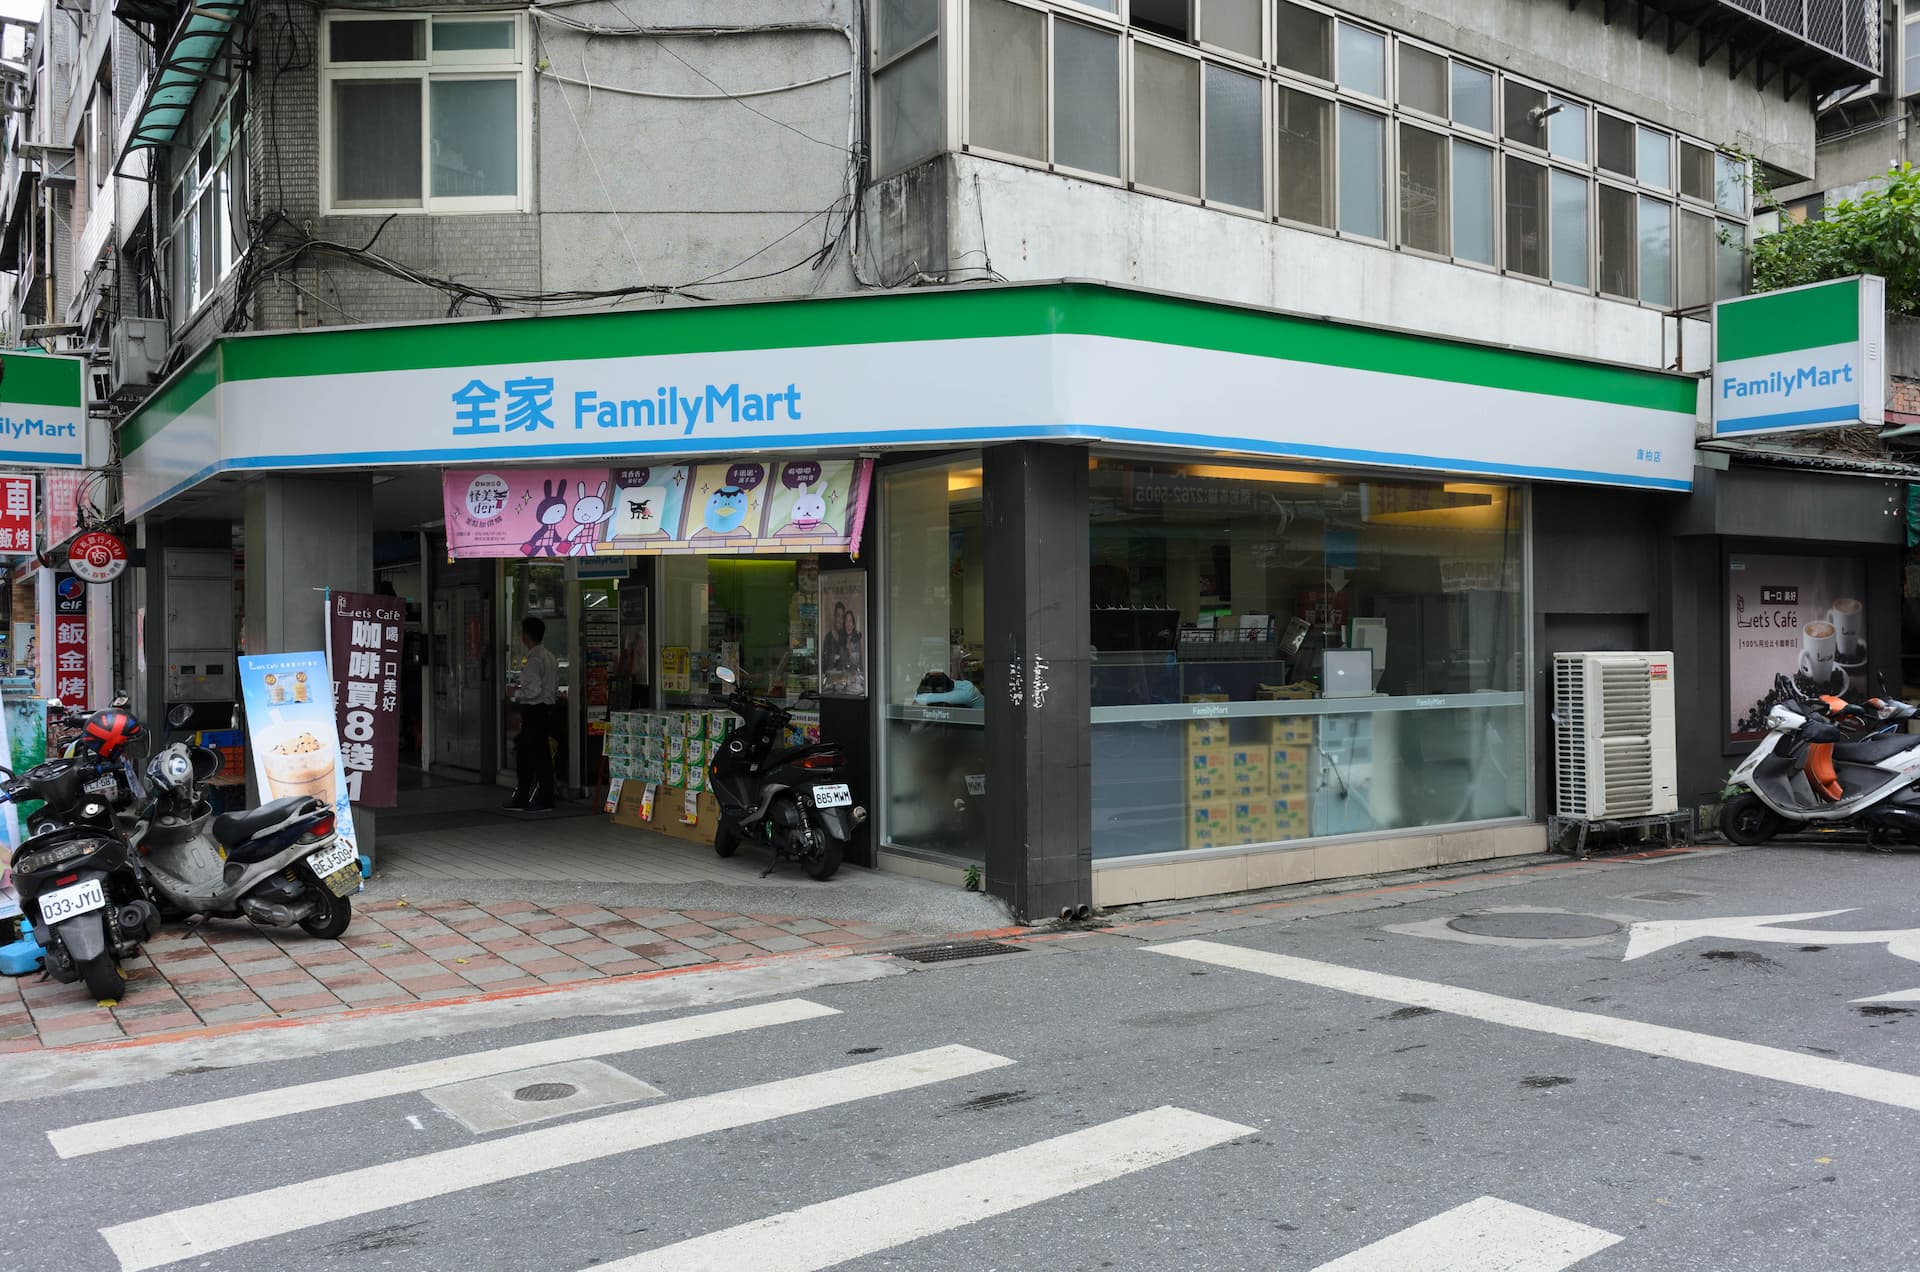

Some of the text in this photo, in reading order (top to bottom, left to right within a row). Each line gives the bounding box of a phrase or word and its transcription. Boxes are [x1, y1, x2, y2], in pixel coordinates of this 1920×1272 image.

[1723, 364, 1852, 399] FamilyMart
[452, 376, 801, 436] 全家 FamilyMart
[0, 480, 30, 521] 車
[60, 600, 83, 610] elf
[376, 608, 401, 621] Café
[1773, 610, 1798, 628] Café
[382, 626, 399, 712] 喝一口美好
[1192, 706, 1229, 716] FamilyMart
